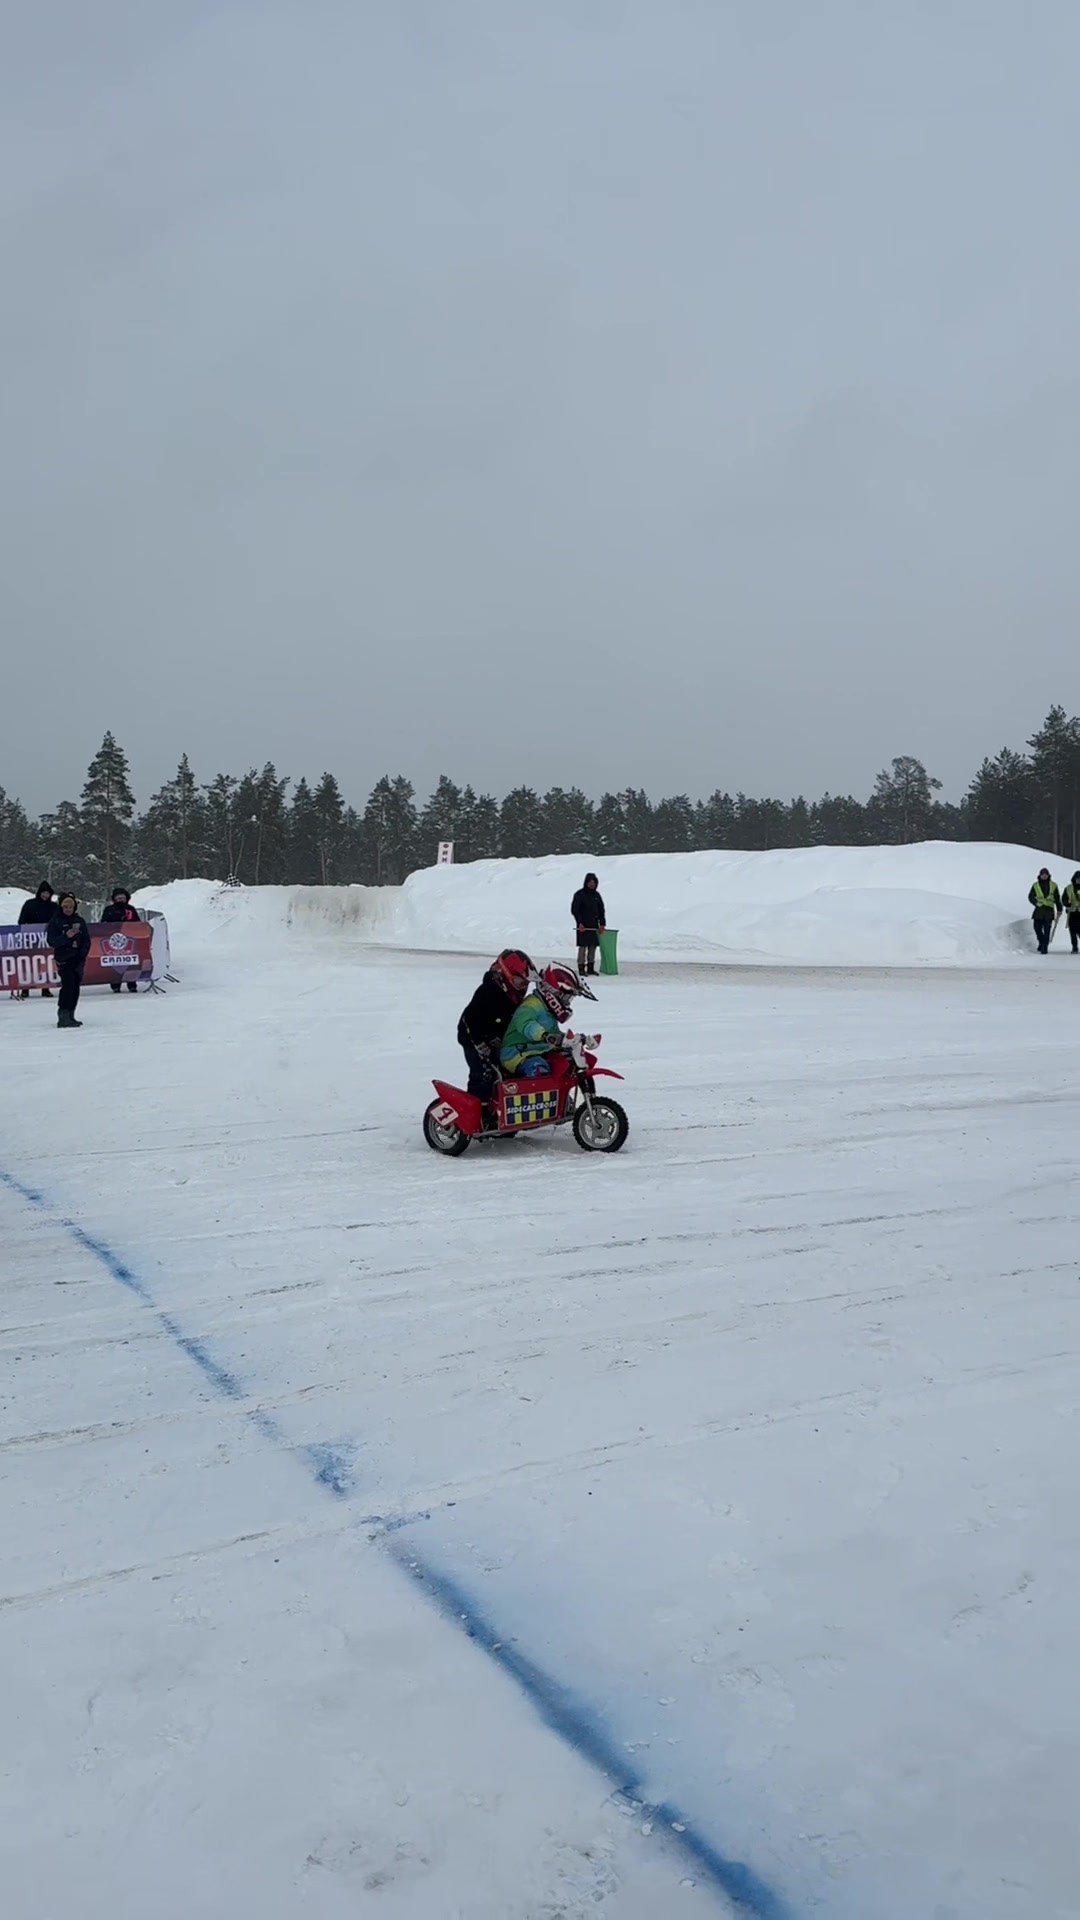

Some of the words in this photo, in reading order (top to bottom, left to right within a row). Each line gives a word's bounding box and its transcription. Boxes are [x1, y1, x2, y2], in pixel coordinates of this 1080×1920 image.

[7, 931, 50, 950] ДЗЕРЖ
[0, 954, 61, 986] РОСС
[437, 1107, 454, 1122] 4
[507, 1101, 557, 1114] SIDECARCROSS
